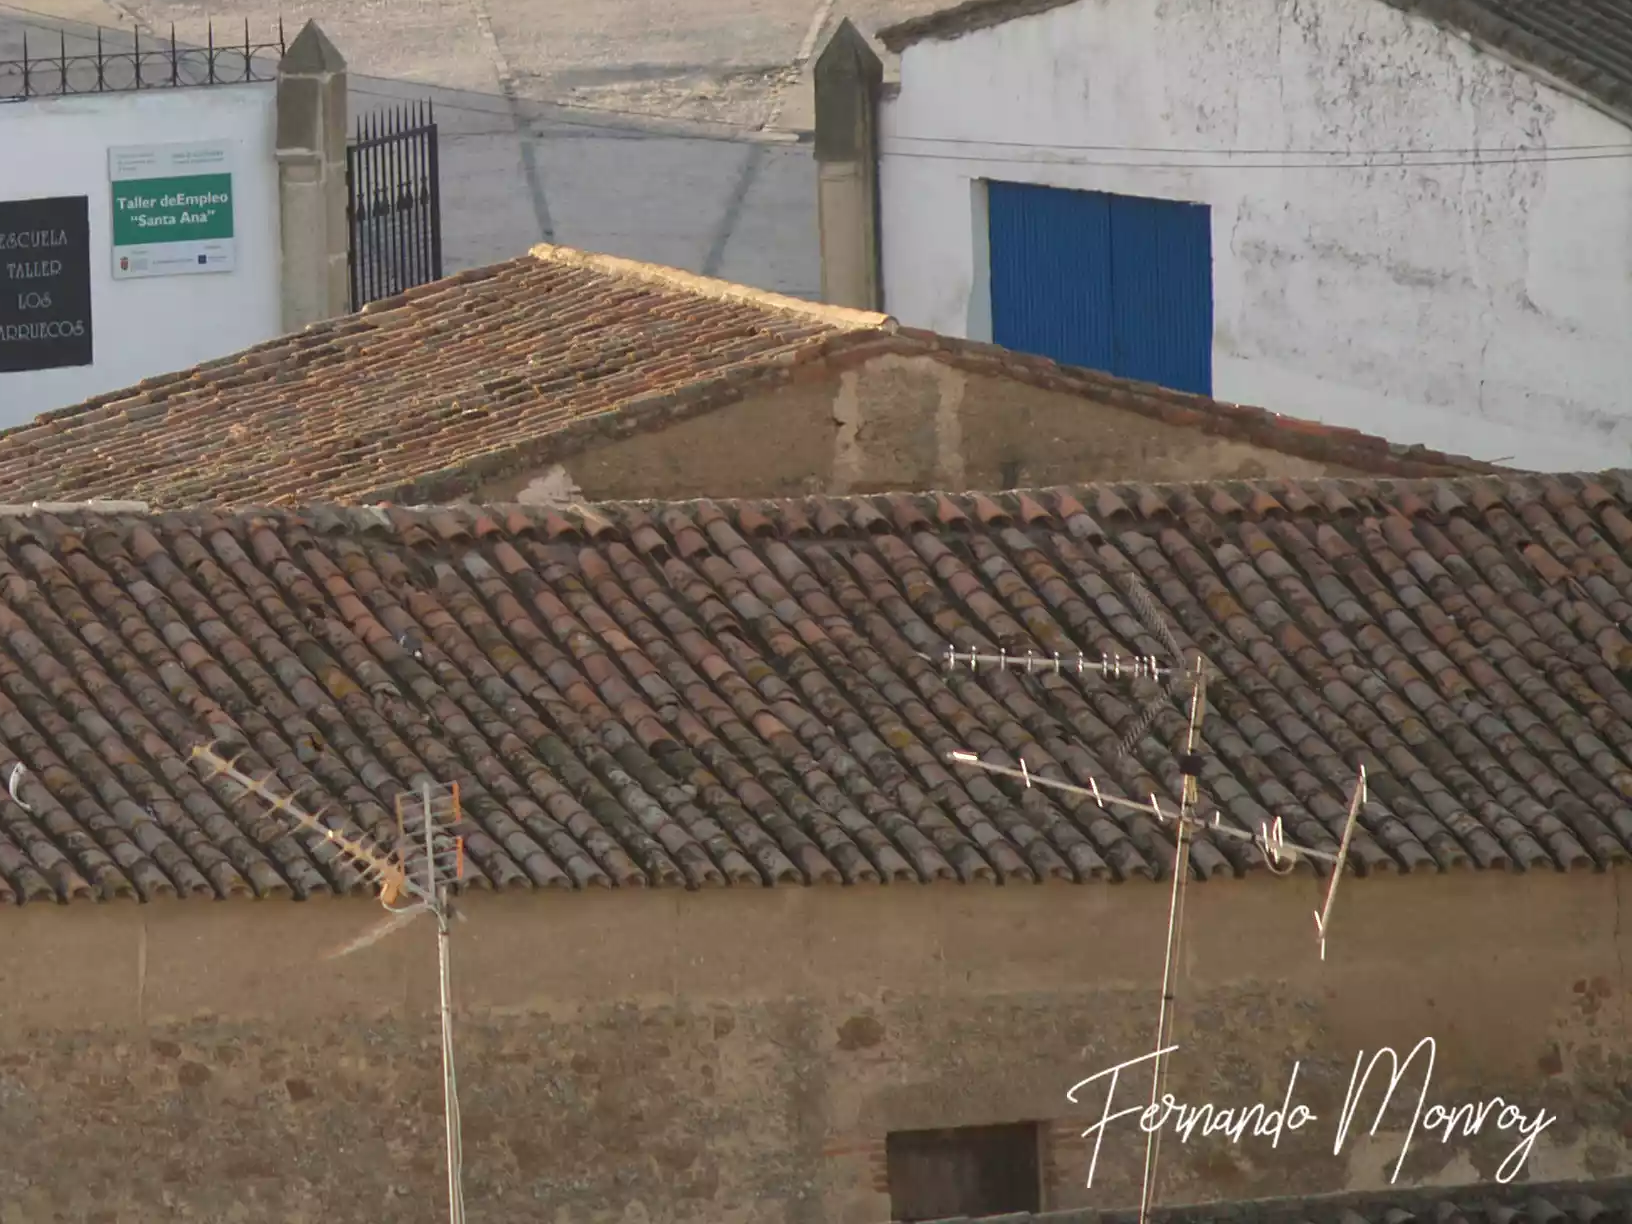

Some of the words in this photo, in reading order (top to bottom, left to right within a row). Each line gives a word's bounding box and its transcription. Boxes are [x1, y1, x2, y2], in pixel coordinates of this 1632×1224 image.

[117, 196, 157, 210] Taller
[6, 260, 62, 280] TALLER
[18, 292, 52, 310] LOS
